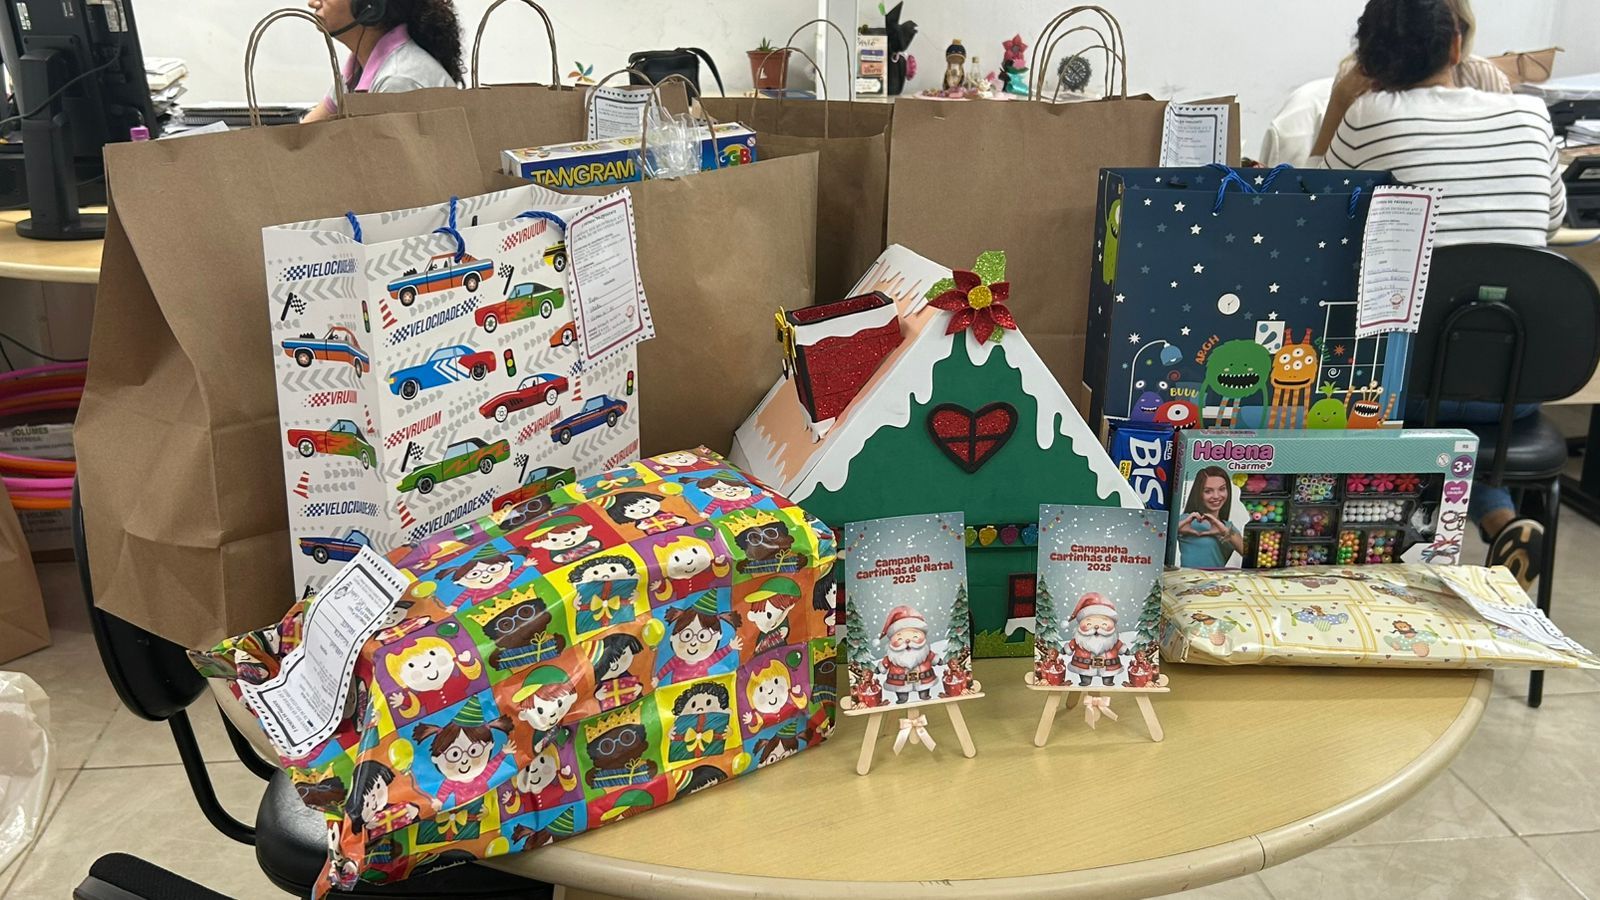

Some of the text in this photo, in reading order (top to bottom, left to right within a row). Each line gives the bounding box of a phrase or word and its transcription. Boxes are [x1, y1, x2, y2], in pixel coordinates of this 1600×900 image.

[531, 158, 635, 187] TANGRAM
[518, 218, 547, 244] VRUUUM
[410, 303, 461, 337] VELOCIDADE
[1195, 334, 1220, 365] ARGH
[1169, 387, 1199, 399] BUUU
[405, 410, 442, 440] VRUUUM
[1164, 440, 1174, 460] LACTA
[1192, 440, 1274, 461] Helena
[1228, 461, 1266, 470] Charme
[1454, 460, 1473, 473] 3+
[428, 496, 478, 534] VELOCIDADE
[1049, 552, 1152, 565] Cartinhas de Natal
[1070, 544, 1128, 555] Campanha
[856, 560, 954, 580] Cartinhas de Natal
[875, 554, 931, 568] Campanha
[1087, 563, 1112, 572] 2025
[893, 574, 917, 585] 2025
